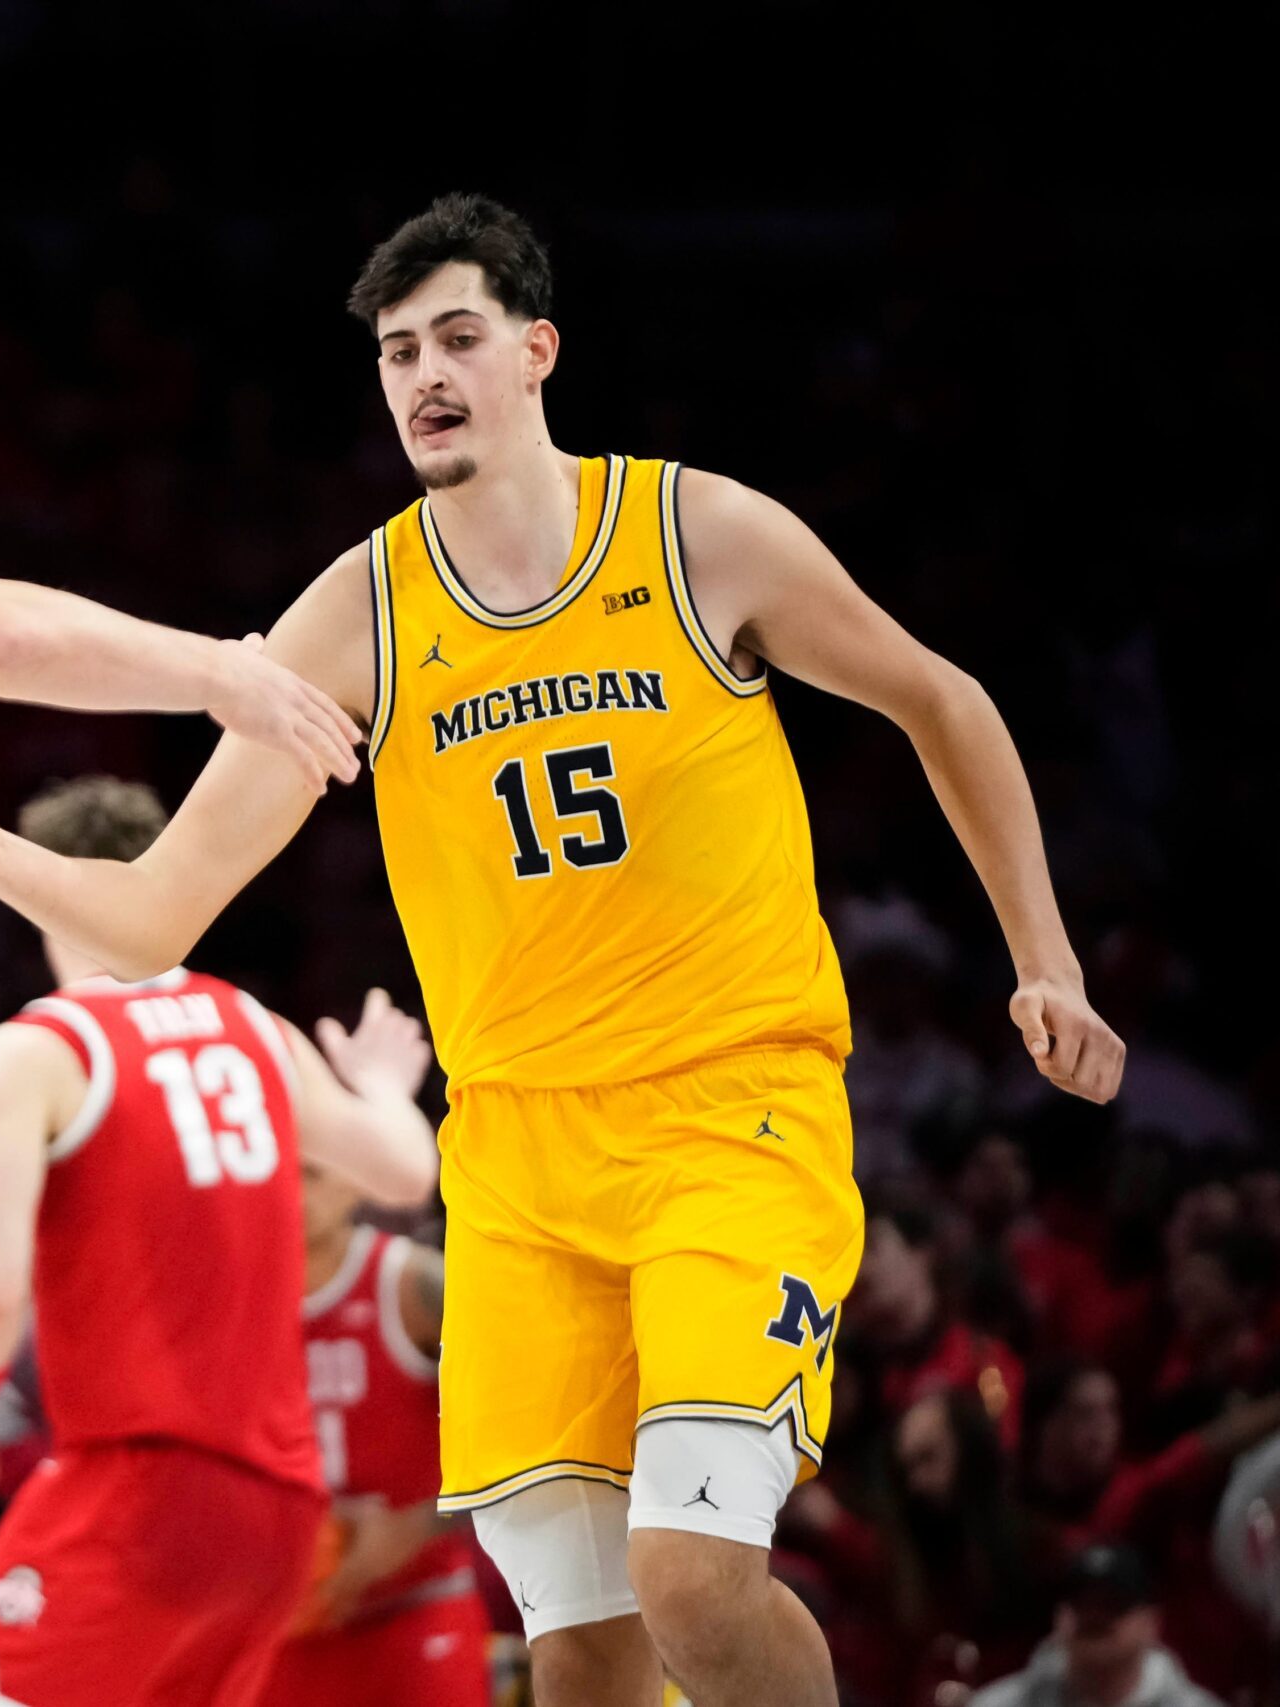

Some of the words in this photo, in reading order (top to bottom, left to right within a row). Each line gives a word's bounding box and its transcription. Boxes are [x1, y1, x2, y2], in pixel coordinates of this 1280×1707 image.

[431, 669, 670, 754] MICHIGAN
[491, 741, 630, 880] 15
[145, 1043, 279, 1187] 13
[764, 1271, 837, 1376] M
